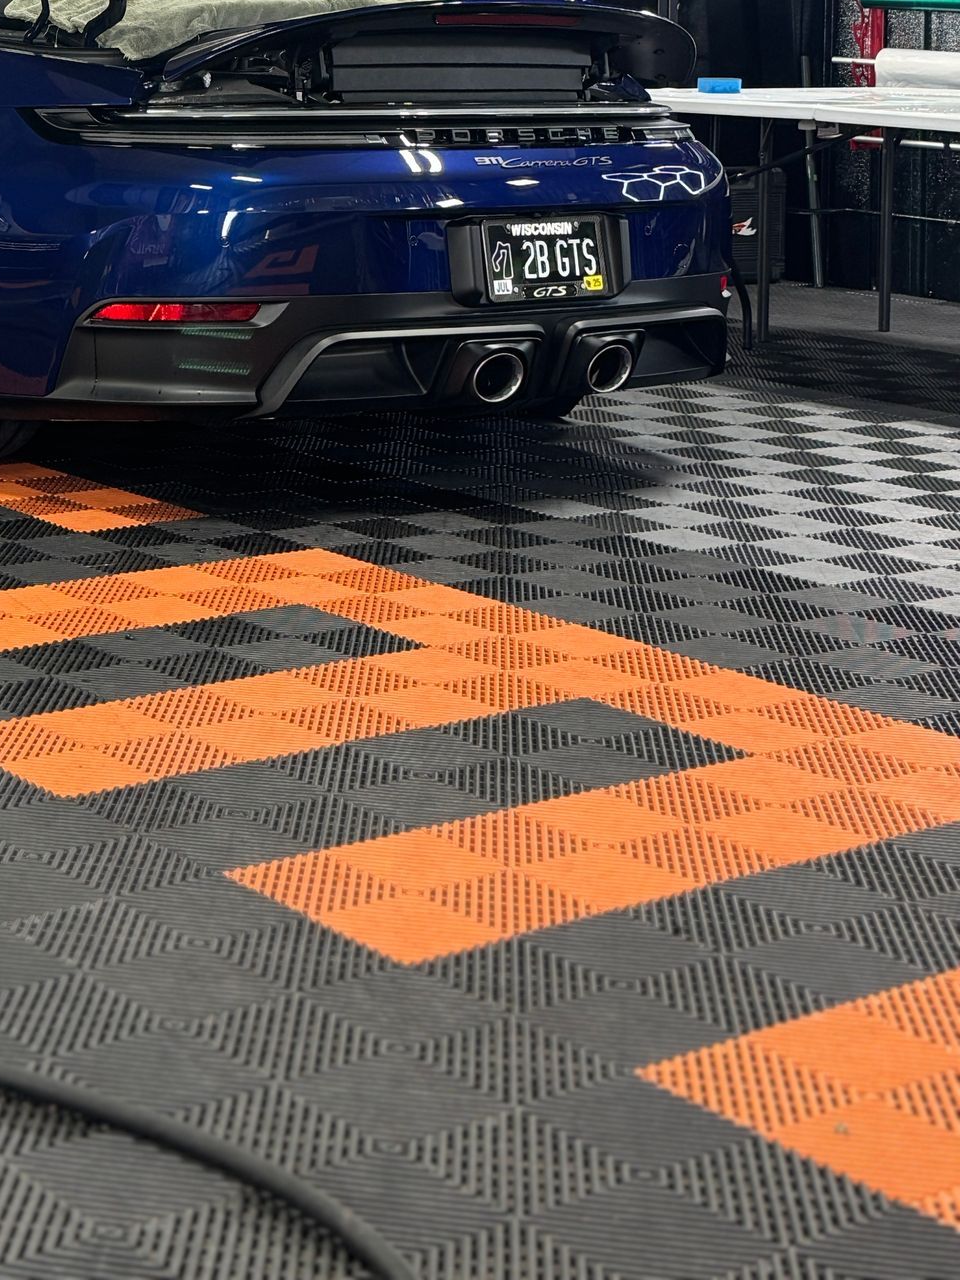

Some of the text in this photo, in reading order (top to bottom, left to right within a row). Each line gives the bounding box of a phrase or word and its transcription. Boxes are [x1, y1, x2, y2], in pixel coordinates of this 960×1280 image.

[416, 127, 620, 142] PORSCHE
[501, 157, 572, 168] Carrera
[573, 156, 613, 166] GTS
[511, 222, 573, 236] WISCONSIN
[522, 238, 597, 279] 2B GTS
[496, 281, 511, 293] JUL
[533, 285, 568, 298] GTS
